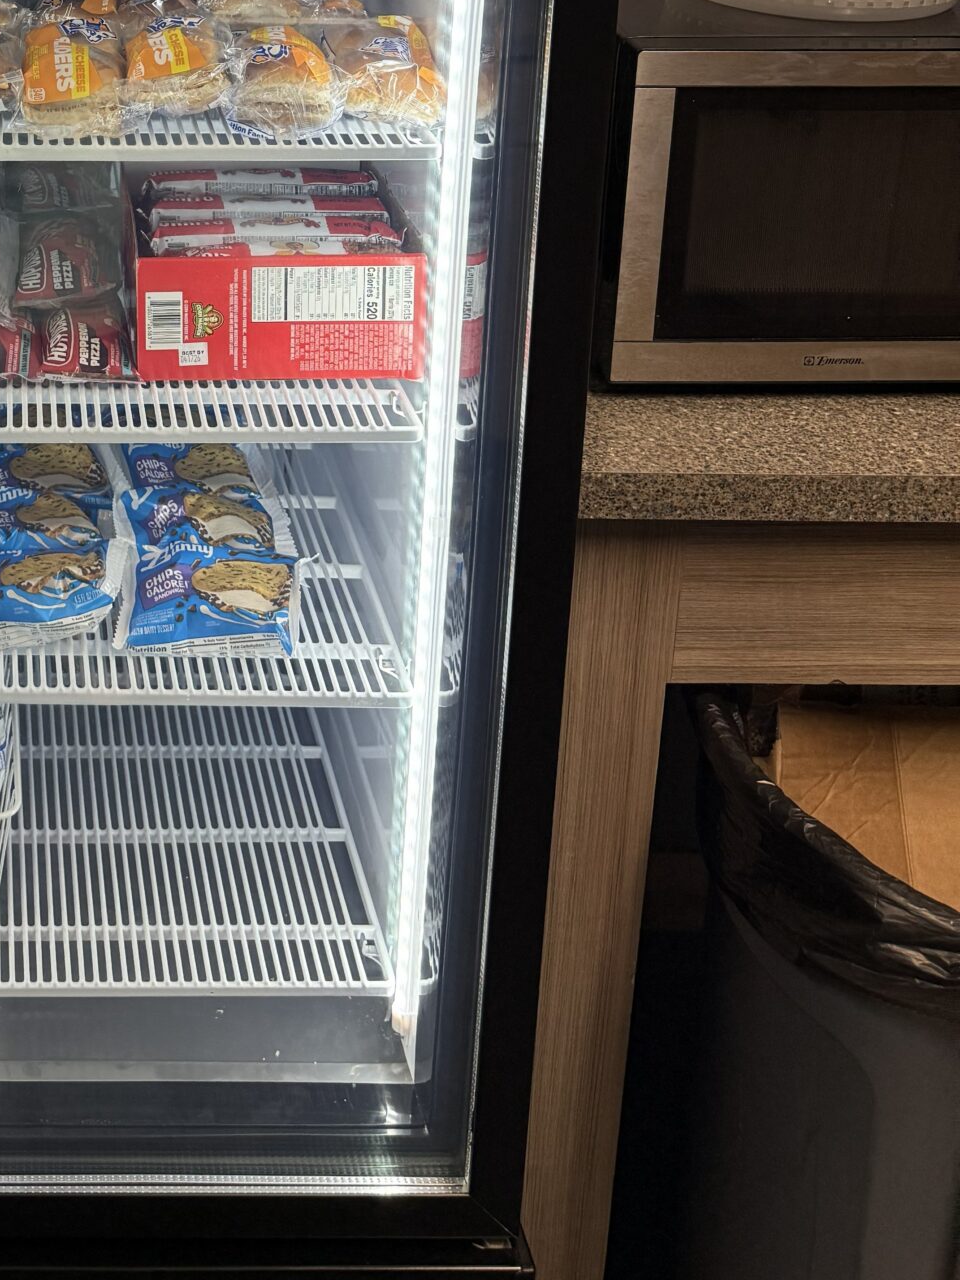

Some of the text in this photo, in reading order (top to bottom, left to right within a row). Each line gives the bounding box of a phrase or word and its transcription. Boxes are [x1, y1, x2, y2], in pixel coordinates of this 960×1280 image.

[367, 267, 378, 320] Calories 520
[90, 337, 101, 367] PIZZA
[136, 459, 168, 471] CHIPS
[145, 568, 183, 588] CHIPS
[146, 579, 189, 598] GALORE!
[154, 588, 185, 602] SANDWICH
